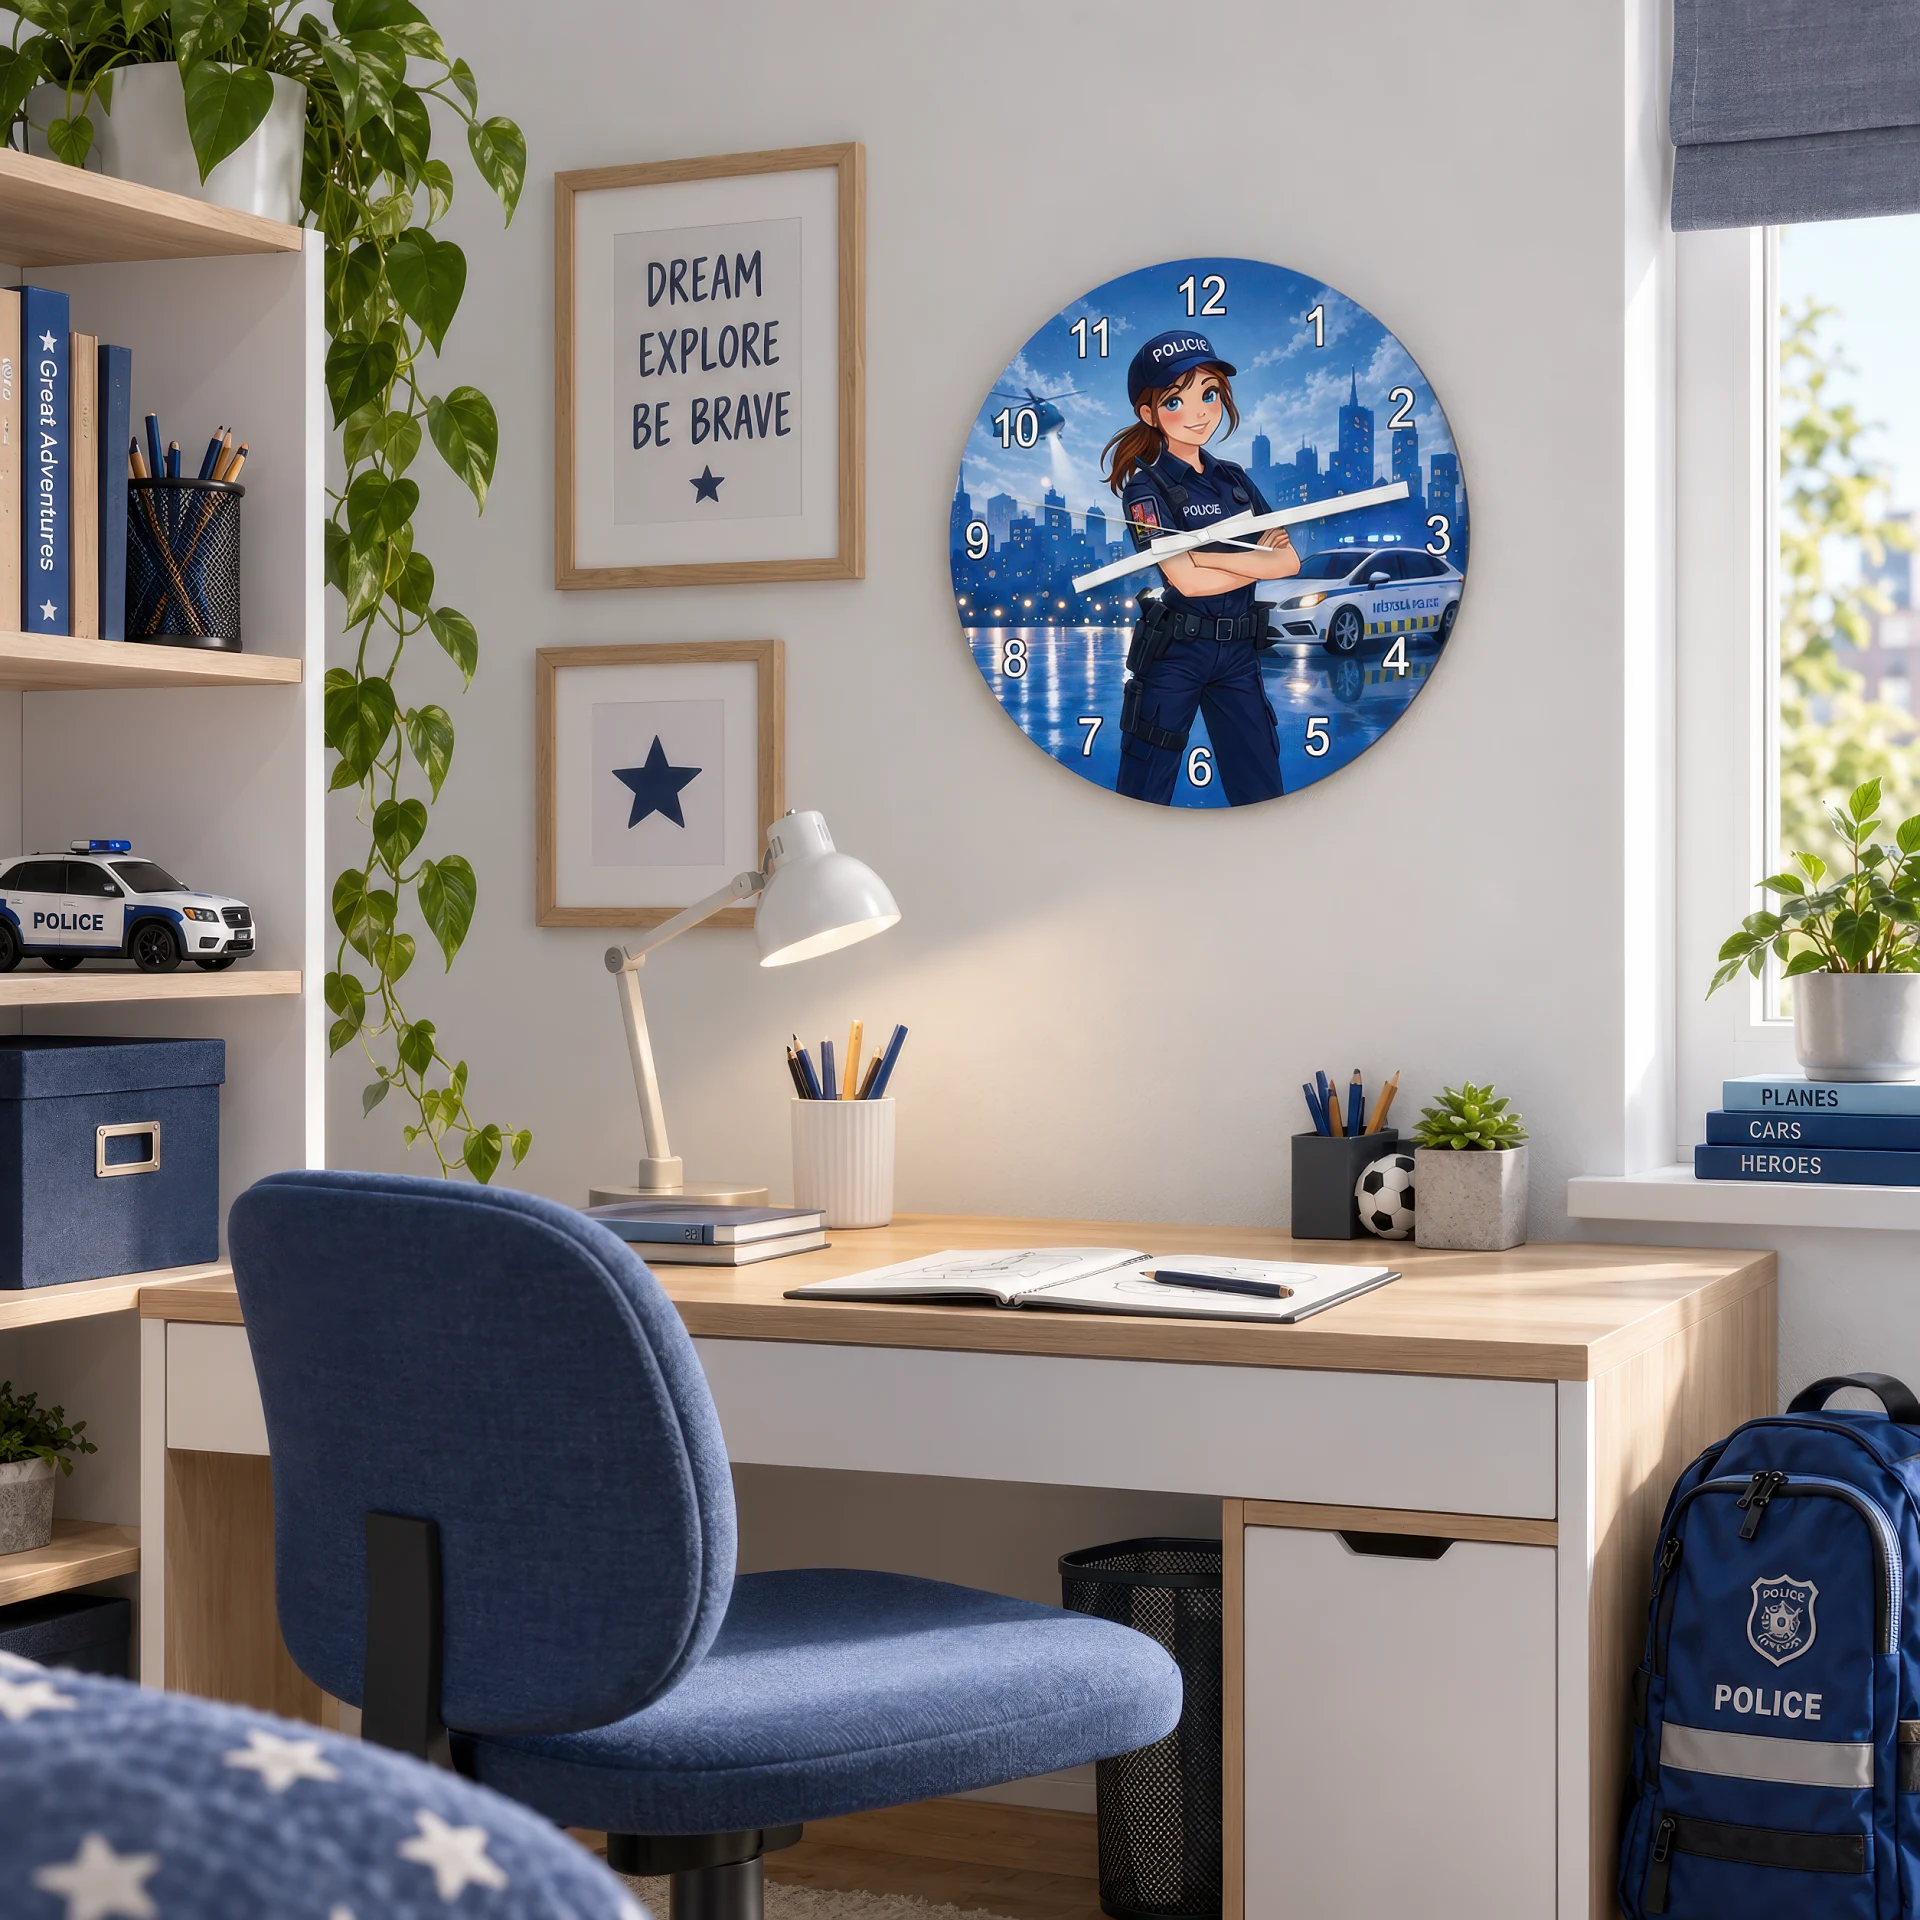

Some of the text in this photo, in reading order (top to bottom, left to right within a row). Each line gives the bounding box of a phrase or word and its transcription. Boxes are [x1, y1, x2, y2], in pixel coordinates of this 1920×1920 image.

[647, 250, 762, 308] DREAM
[1178, 274, 1227, 317] 12
[1070, 317, 1110, 358] 11
[1306, 305, 1325, 347] 1
[639, 321, 780, 378] EXPLORE
[632, 391, 791, 450] BE BRAVE
[994, 408, 1039, 449] 10
[1387, 386, 1416, 430] 2
[40, 360, 58, 571] Great Adventures
[965, 519, 989, 560] 9
[1426, 515, 1450, 556] 3
[1002, 638, 1028, 678] 8
[1382, 636, 1410, 676] 4
[1077, 715, 1103, 756] 7
[1304, 716, 1330, 757] 5
[1187, 747, 1212, 787] 6
[33, 912, 103, 931] POLICE
[1762, 1088, 1838, 1107] PLANES
[1749, 1121, 1801, 1140] CARS
[1741, 1154, 1821, 1175] HEROES
[1714, 1684, 1822, 1720] POLICE
